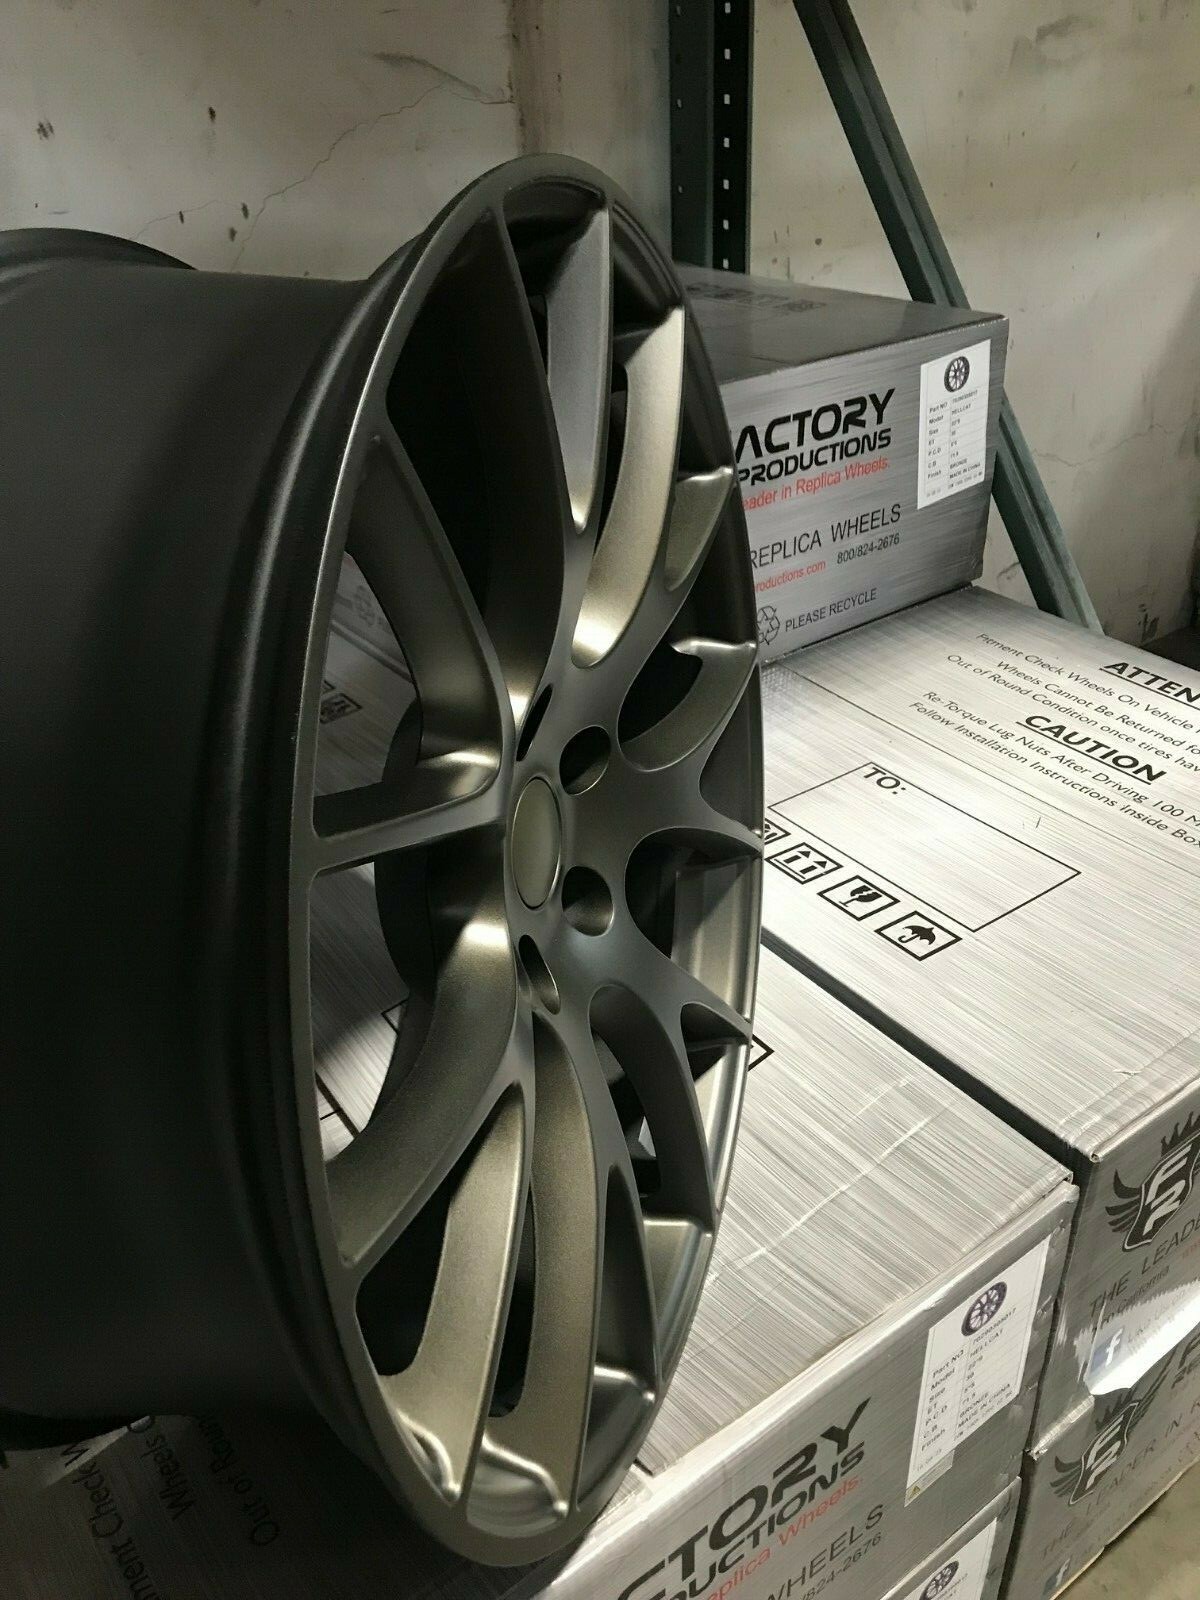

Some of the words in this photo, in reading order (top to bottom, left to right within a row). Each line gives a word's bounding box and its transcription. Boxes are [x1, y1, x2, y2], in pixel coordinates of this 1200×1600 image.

[736, 387, 895, 463] ACTORY
[781, 485, 792, 499] in
[796, 468, 841, 495] Replica
[831, 503, 901, 542] WHEELS
[837, 532, 900, 565] 800/824-2676
[785, 605, 827, 632] PLEASE
[829, 587, 877, 617] RECYCLE
[947, 654, 972, 670] Out
[972, 664, 990, 677] of
[988, 674, 1036, 696] Round
[1032, 693, 1098, 727] Condition
[1100, 725, 1136, 743] once
[1138, 741, 1173, 760] tires
[996, 661, 1042, 685] Wheels
[1044, 682, 1094, 708] Cannot
[1094, 704, 1114, 717] Be
[1116, 714, 1186, 746] Returned
[1025, 653, 1064, 676] Check
[1067, 671, 1115, 697] Wheels
[1118, 694, 1140, 708] On
[1144, 703, 1194, 730] Vehicle
[909, 702, 955, 728] Follow
[954, 722, 1035, 766] Installation
[1029, 761, 1118, 808] Instructions
[1119, 804, 1168, 831] Inside
[923, 691, 988, 727] Re-Torque
[988, 723, 1015, 741] Lug
[1015, 735, 1050, 756] Nuts
[1051, 753, 1093, 775] After
[1092, 771, 1149, 804] Driving
[1152, 800, 1184, 817] 100
[1025, 714, 1167, 782] CAUTION
[863, 766, 907, 795] TO:
[1090, 1270, 1131, 1317] THE
[931, 1368, 955, 1390] Model
[922, 1428, 945, 1450] Finish
[958, 1409, 978, 1428] MADE
